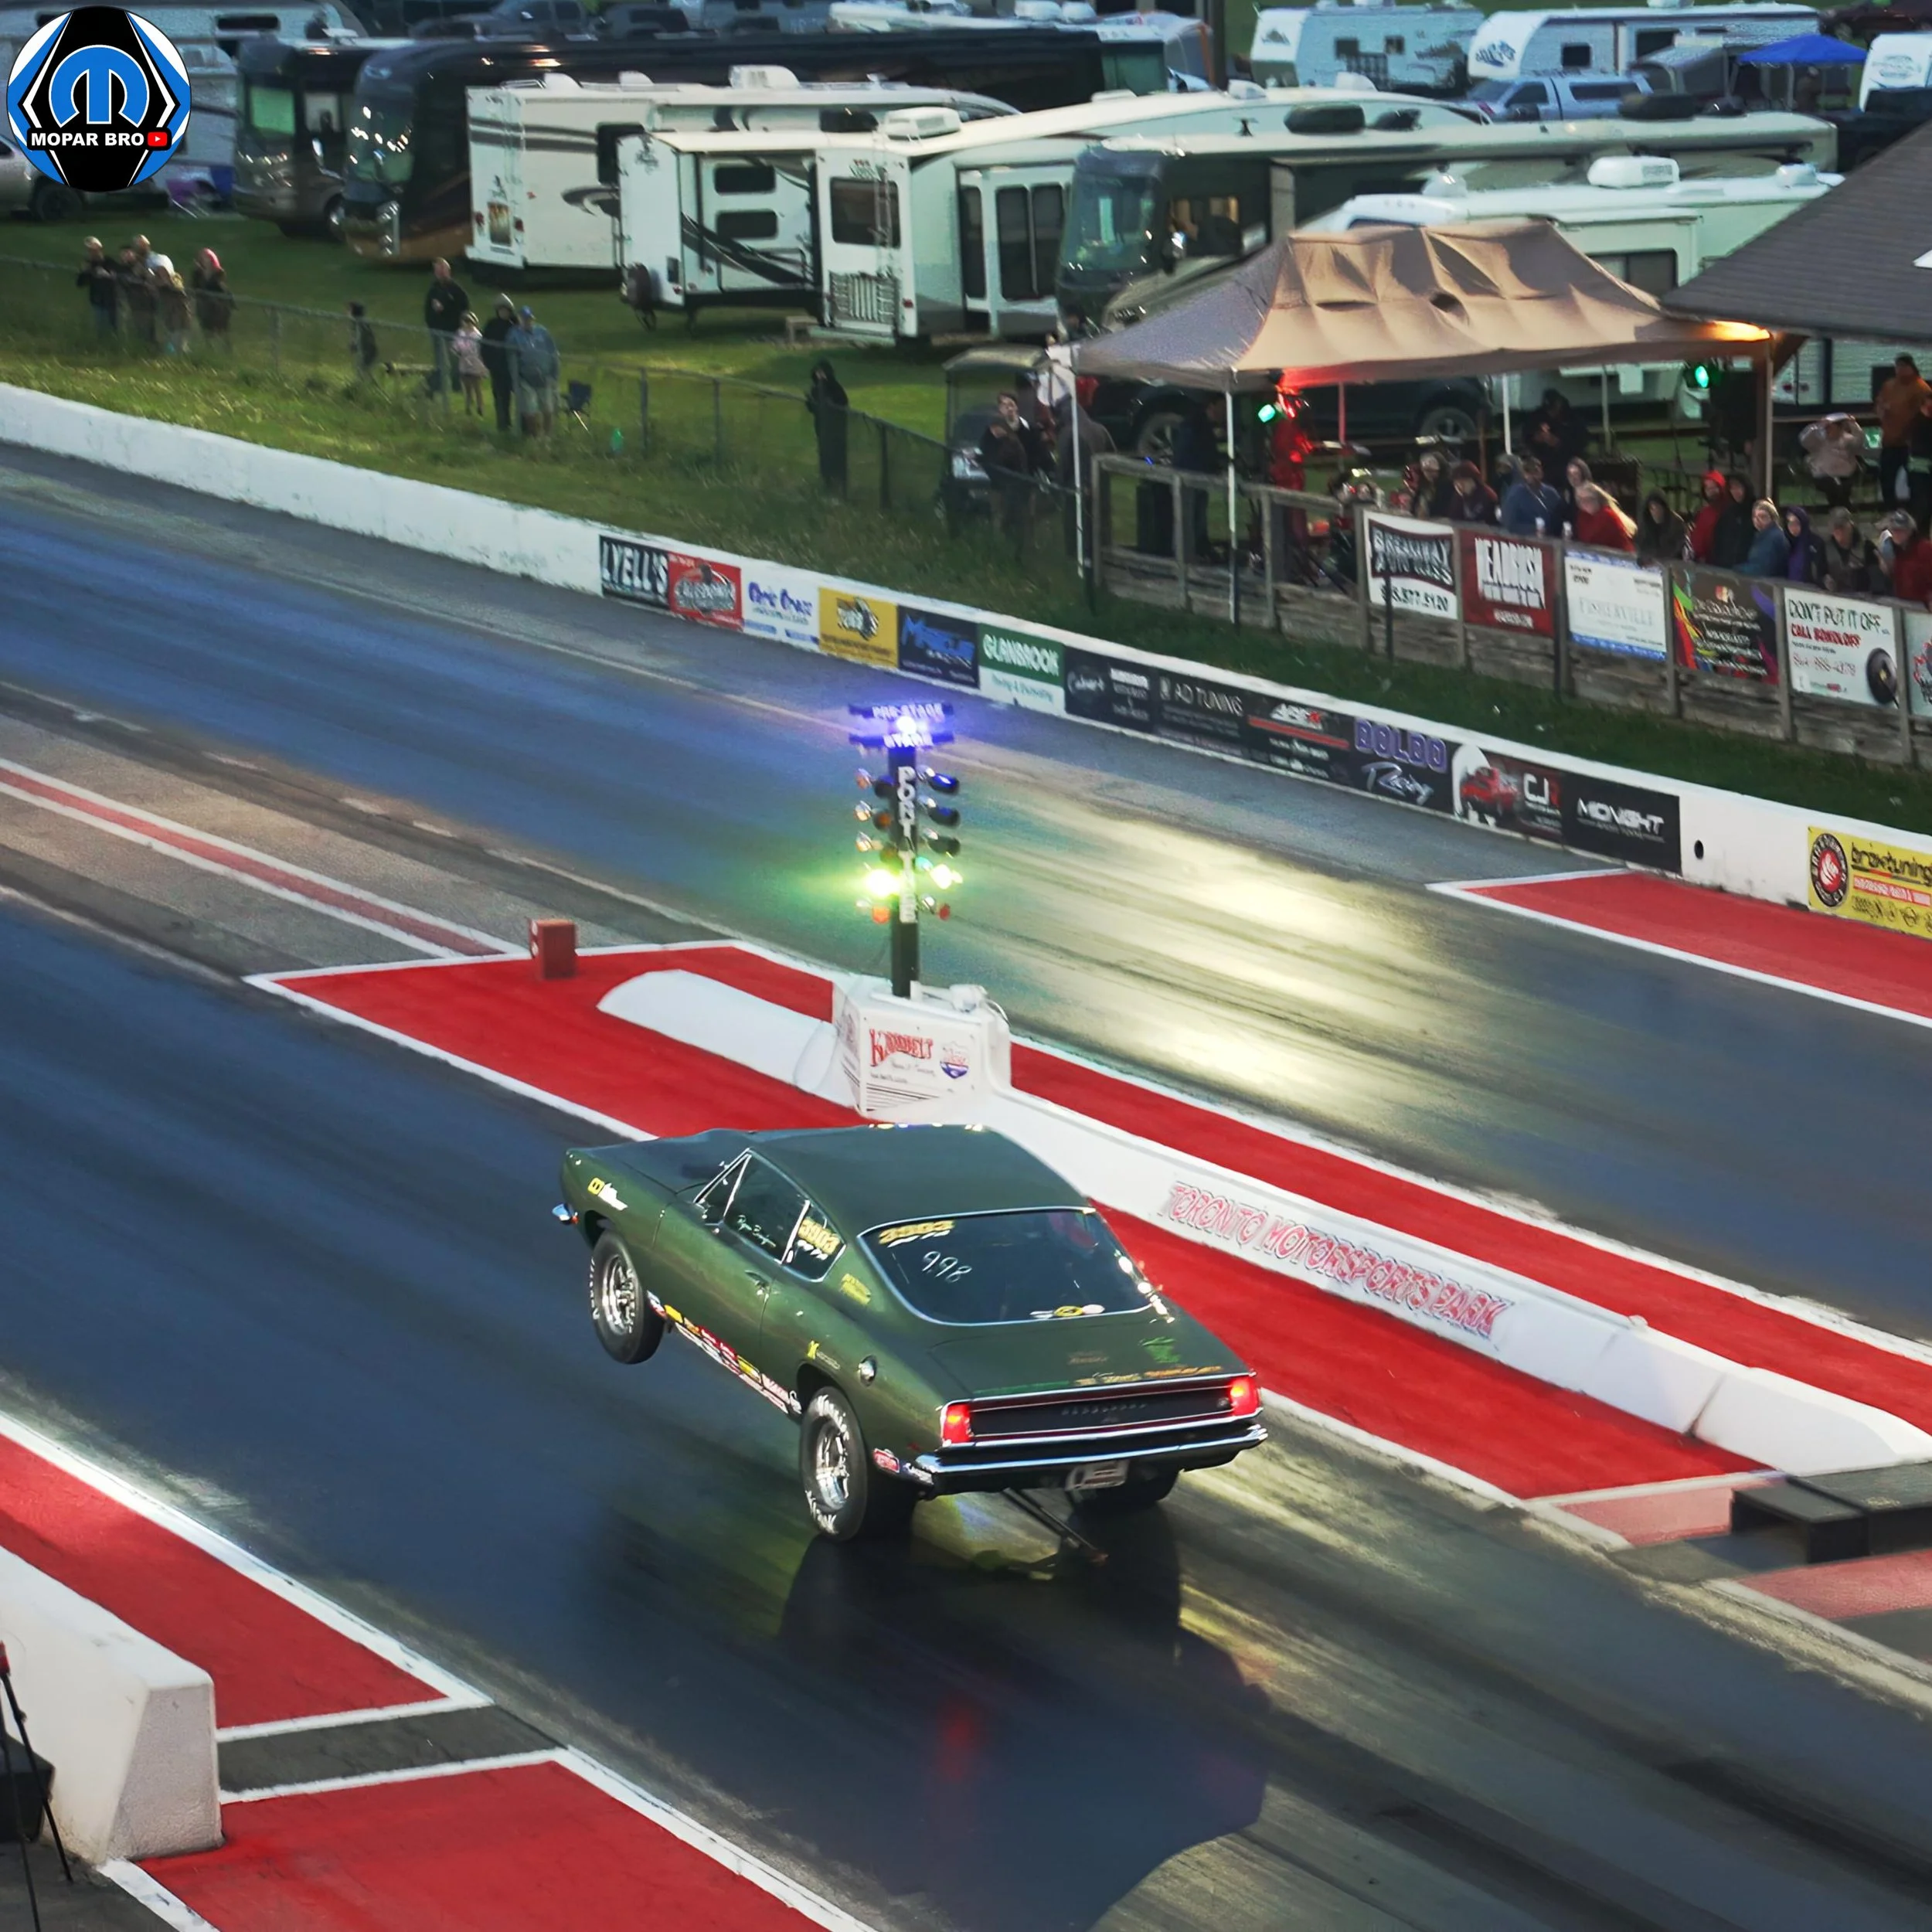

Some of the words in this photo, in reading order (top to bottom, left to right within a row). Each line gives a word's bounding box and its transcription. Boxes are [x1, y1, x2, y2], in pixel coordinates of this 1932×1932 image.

[1824, 605, 1845, 626] PUT
[1847, 608, 1858, 630] IT
[1791, 622, 1812, 640] CALL
[1168, 1182, 1268, 1246] TORONTO
[1260, 1214, 1440, 1311] MOTORSPORTS
[1428, 1277, 1513, 1339] PARK
